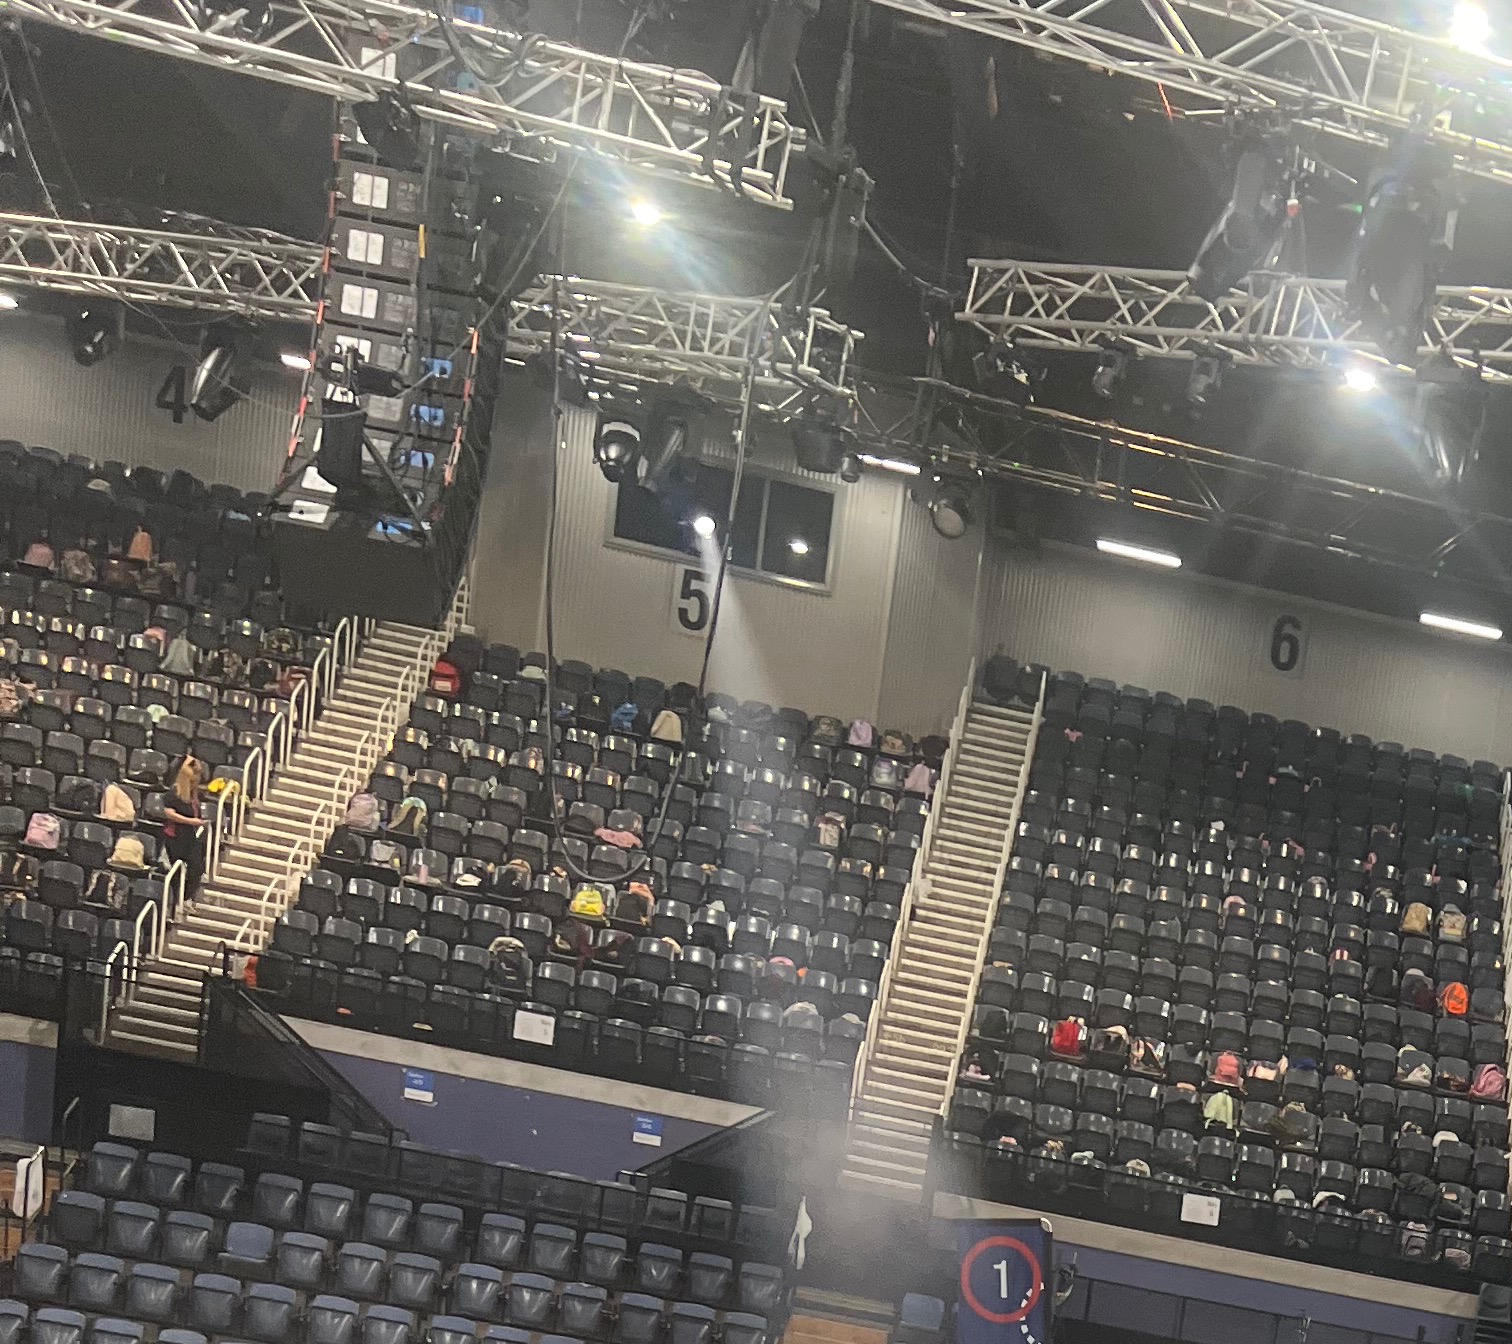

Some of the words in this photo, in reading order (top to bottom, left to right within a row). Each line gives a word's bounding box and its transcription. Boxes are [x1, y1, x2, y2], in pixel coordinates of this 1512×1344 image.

[156, 366, 189, 424] 4
[678, 568, 711, 630] 5
[1271, 615, 1302, 671] 6
[993, 1260, 1008, 1299] 1
